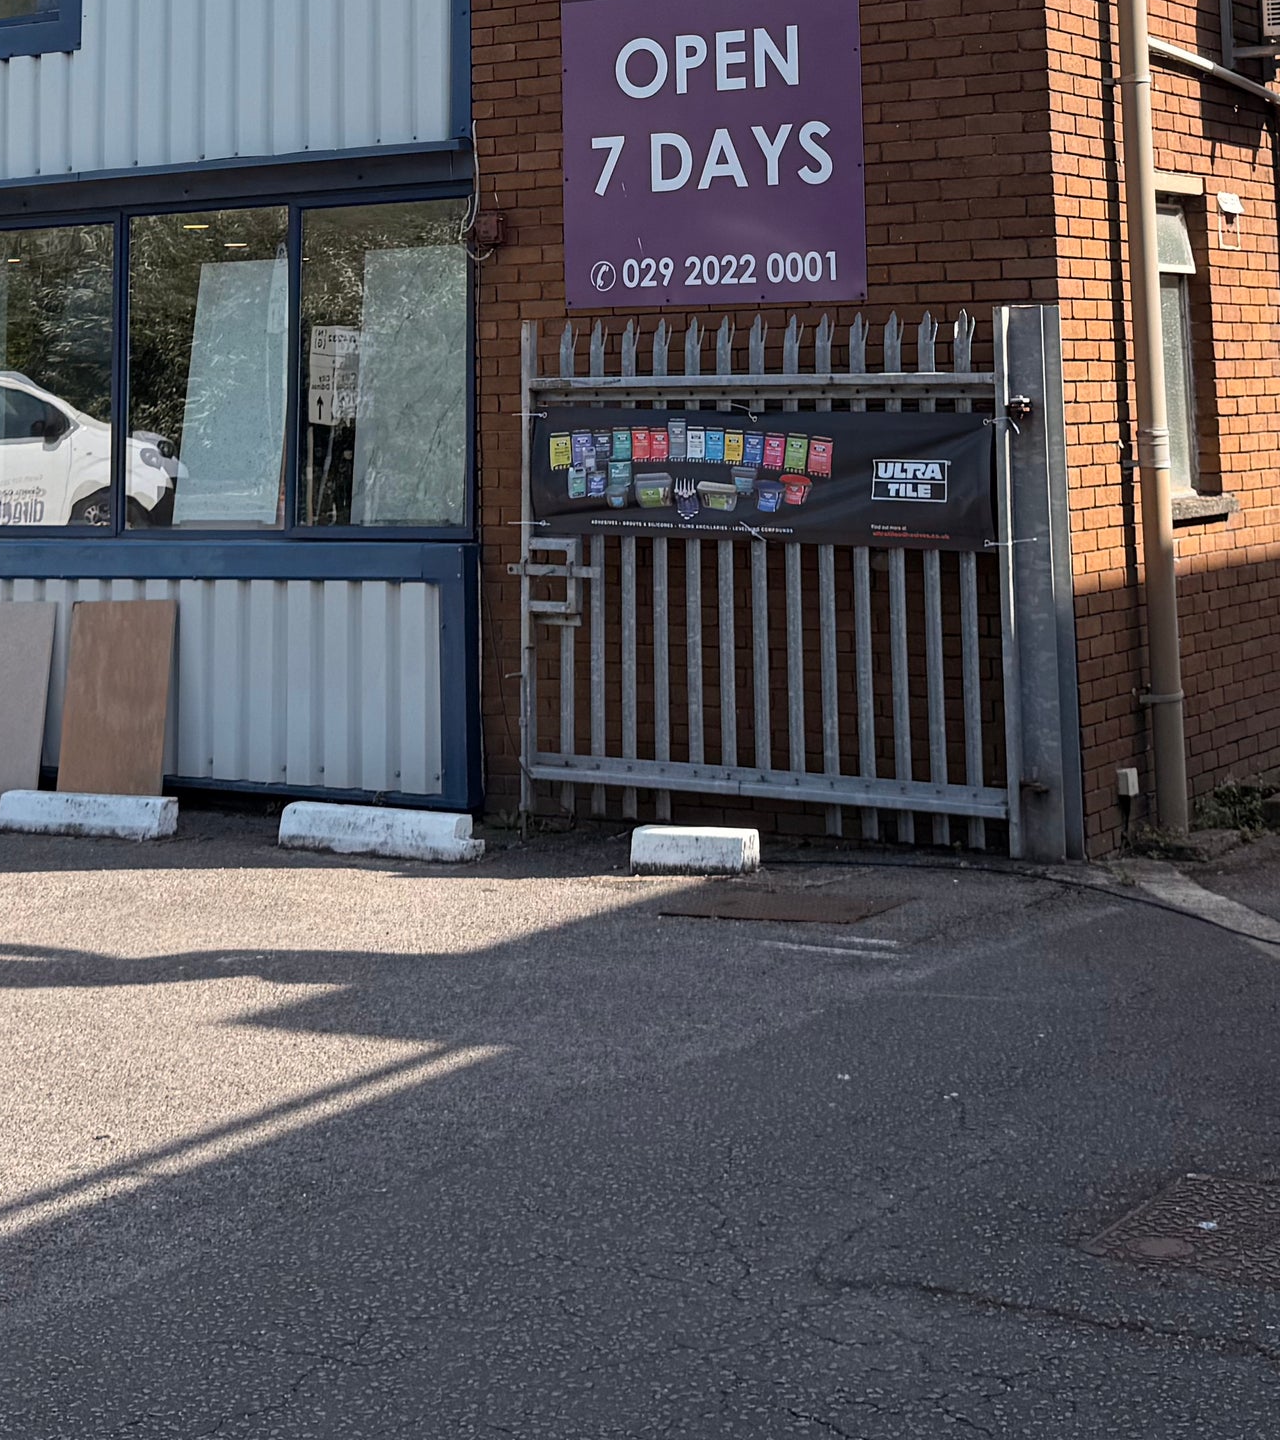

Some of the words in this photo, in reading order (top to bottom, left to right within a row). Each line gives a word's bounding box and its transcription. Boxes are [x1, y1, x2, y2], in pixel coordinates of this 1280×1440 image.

[615, 25, 799, 99] OPEN
[591, 136, 626, 196] 7
[651, 121, 834, 192] DAYS
[622, 257, 673, 288] 029
[685, 254, 757, 284] 2022
[766, 251, 838, 282] 0001
[877, 462, 943, 480] ULTRA
[888, 483, 931, 498] TILE
